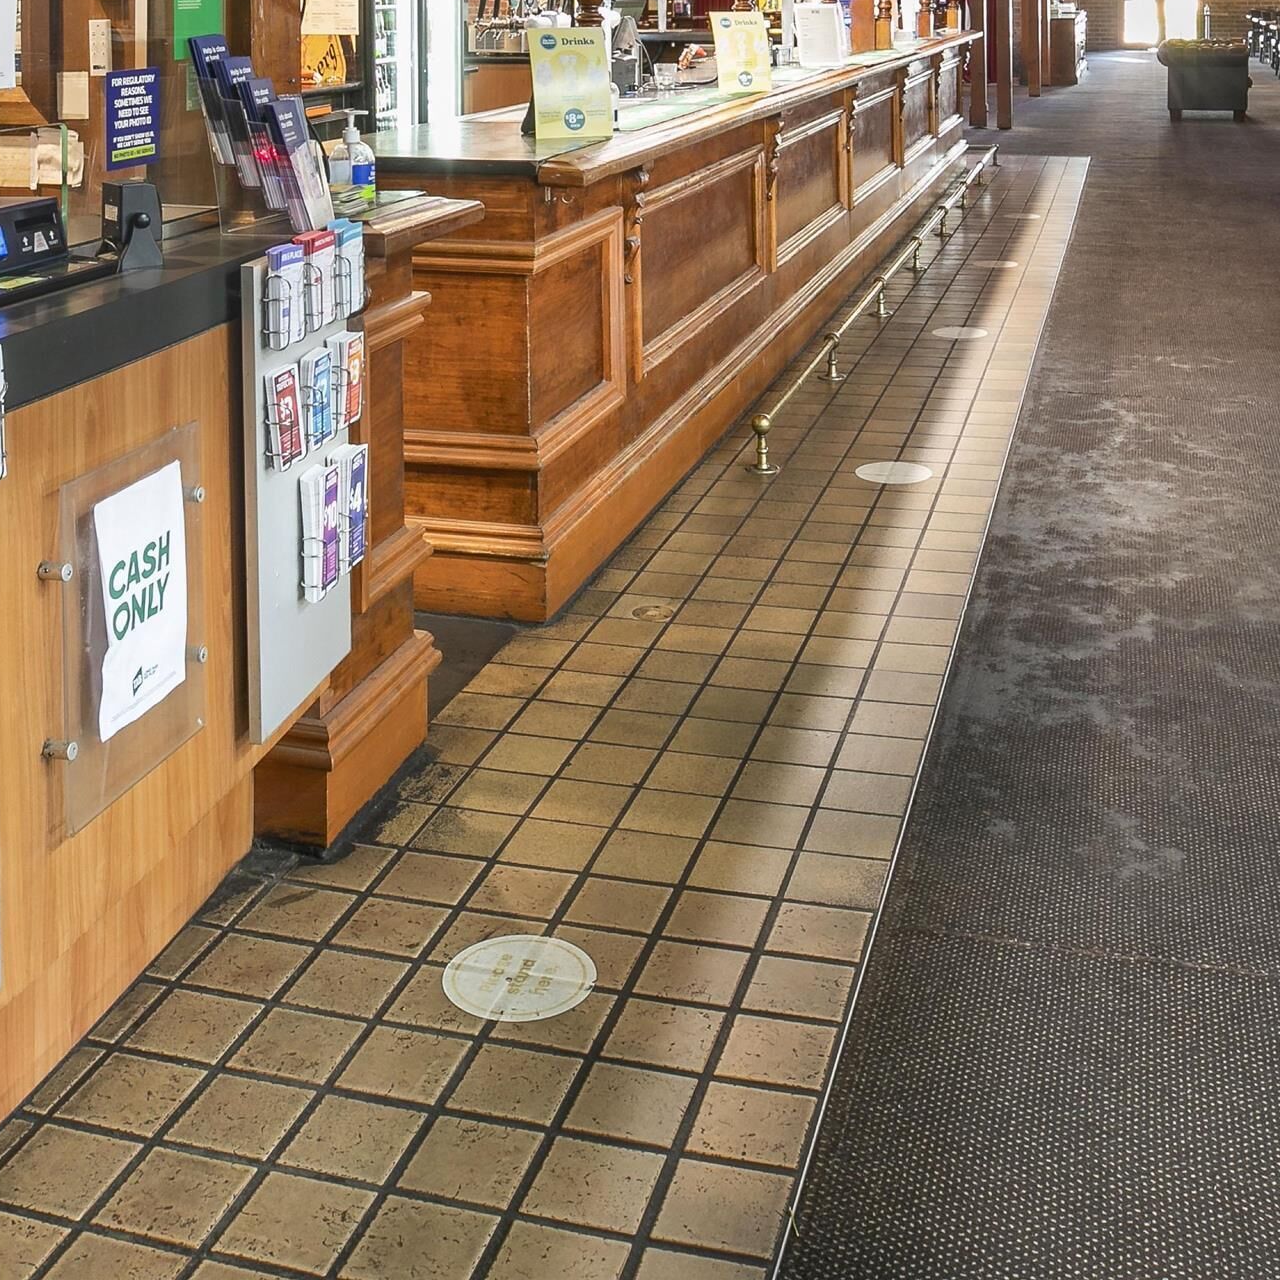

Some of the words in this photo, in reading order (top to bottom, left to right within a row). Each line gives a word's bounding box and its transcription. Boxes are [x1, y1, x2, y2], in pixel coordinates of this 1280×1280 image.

[561, 37, 596, 47] Drinks
[108, 529, 171, 601] CASH
[112, 570, 170, 642] ONLY
[506, 958, 538, 996] stand
